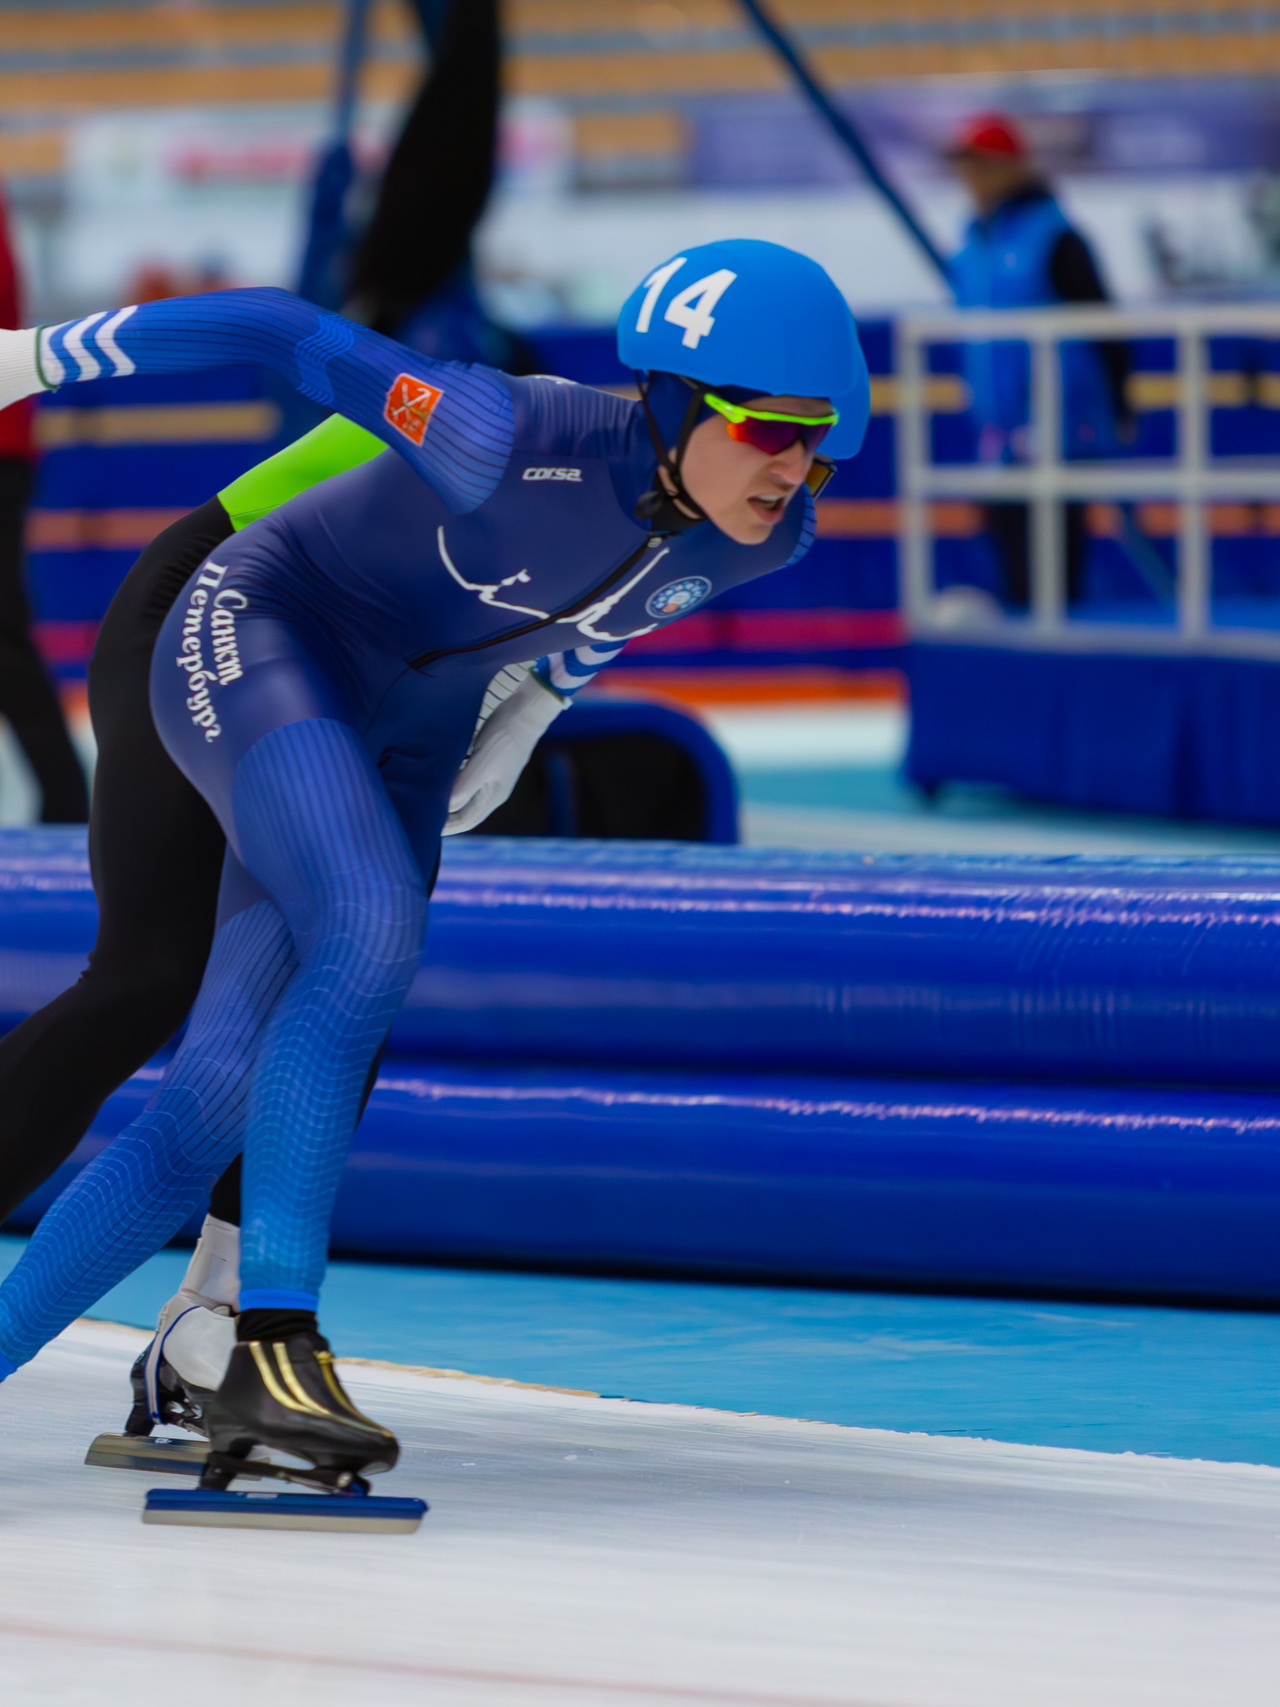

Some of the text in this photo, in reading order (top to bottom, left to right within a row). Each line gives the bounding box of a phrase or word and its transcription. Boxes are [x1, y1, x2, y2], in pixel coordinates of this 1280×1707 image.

[635, 257, 738, 349] 14
[176, 560, 229, 743] Петербург
[210, 588, 248, 686] Санкт
